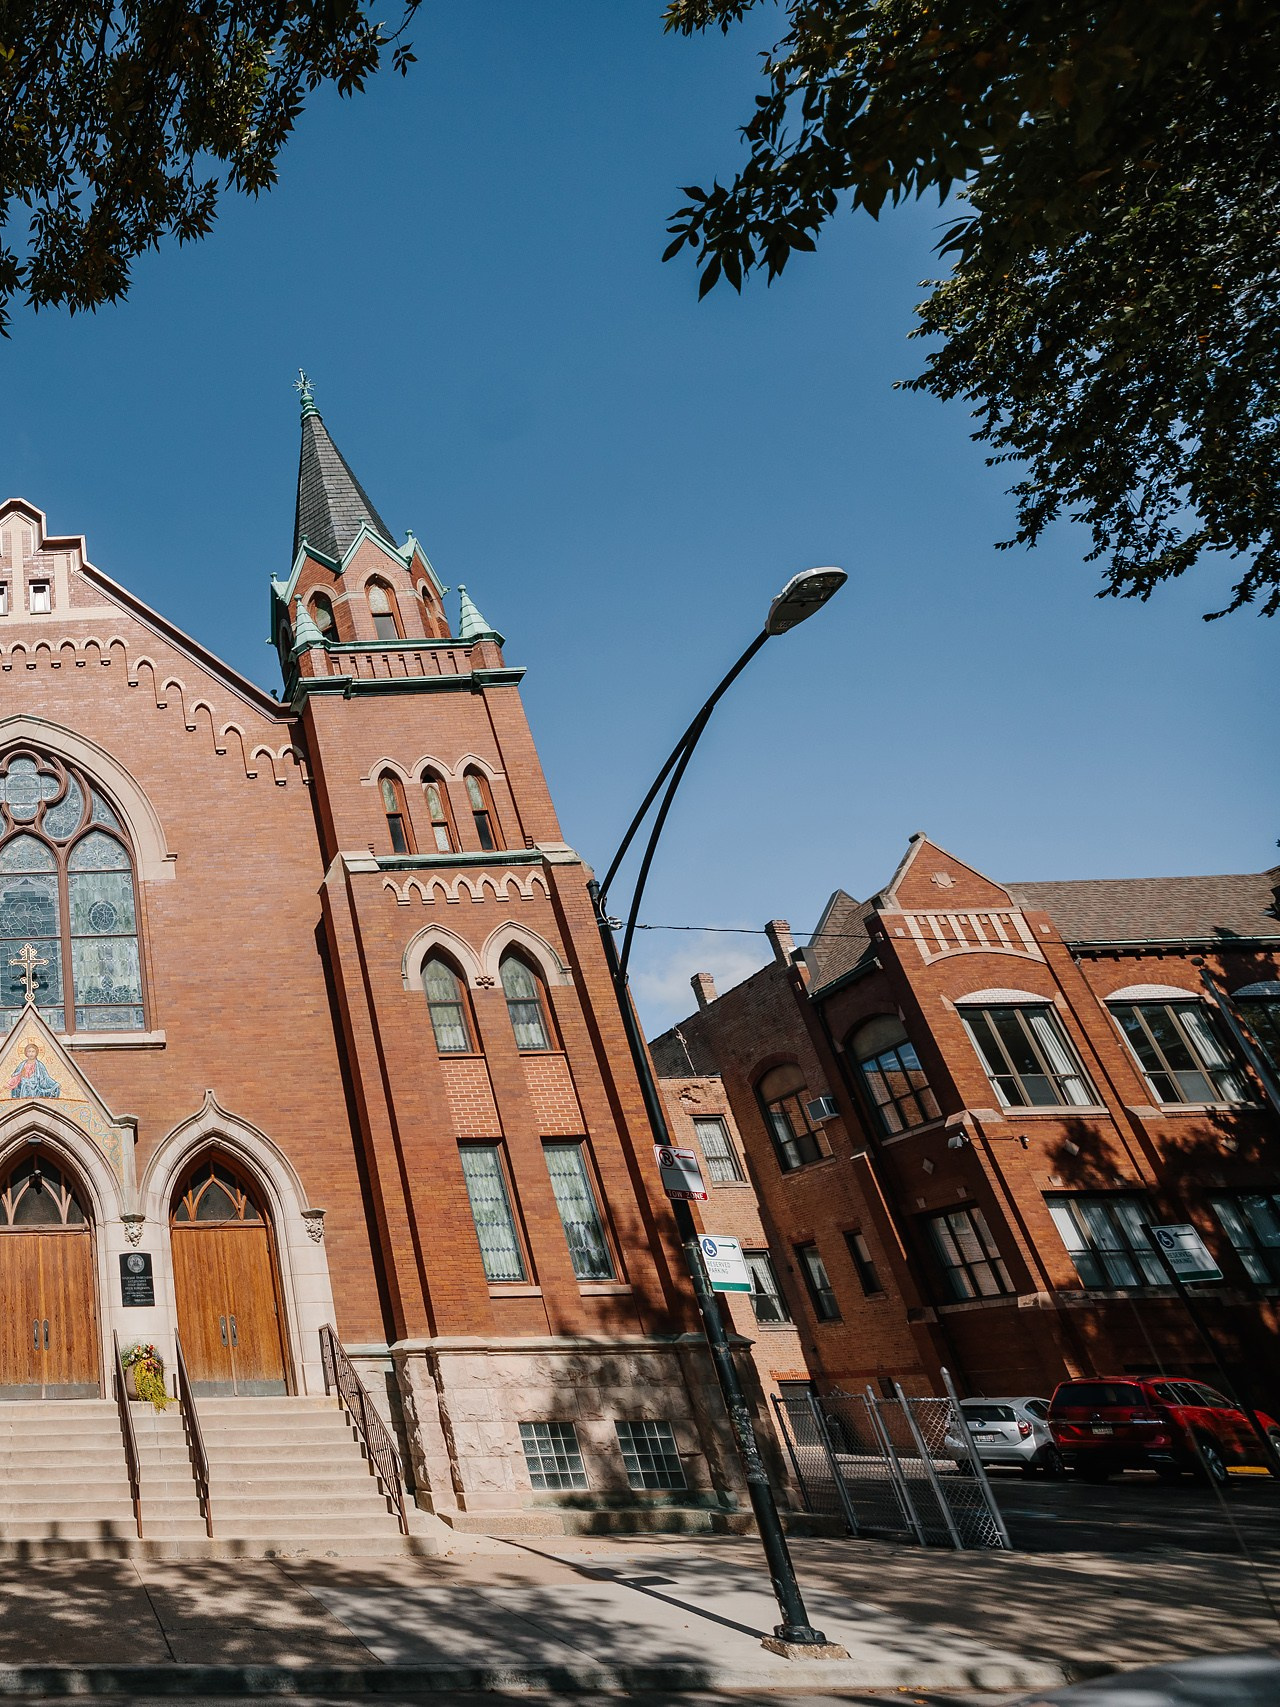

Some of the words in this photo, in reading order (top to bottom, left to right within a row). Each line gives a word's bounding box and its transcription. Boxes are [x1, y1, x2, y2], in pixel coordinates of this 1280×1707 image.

[668, 1190, 683, 1198] TOW
[685, 1191, 704, 1200] ZONE
[706, 1261, 731, 1269] RESERVED
[708, 1267, 729, 1275] PARKING
